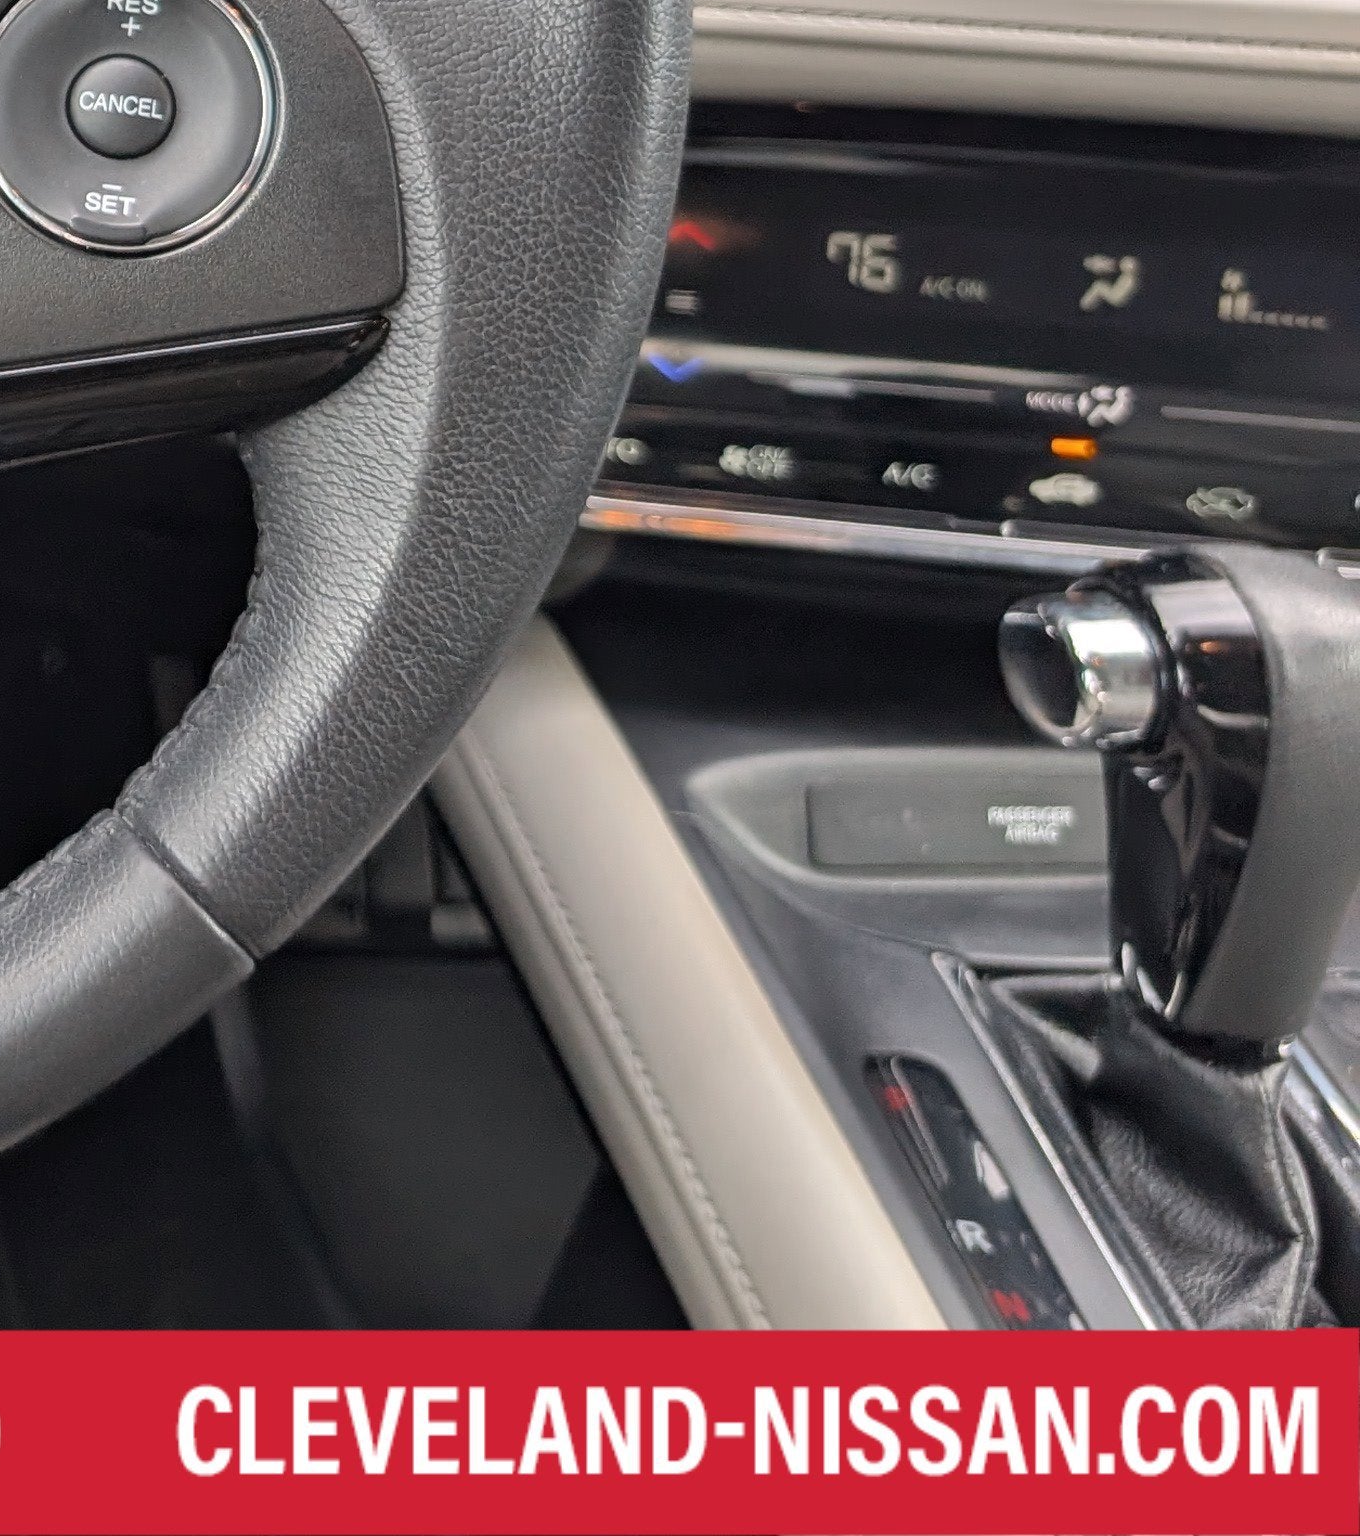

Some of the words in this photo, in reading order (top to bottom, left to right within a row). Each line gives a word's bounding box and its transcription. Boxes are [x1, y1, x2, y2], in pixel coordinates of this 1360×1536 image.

[79, 90, 163, 120] CANCEL
[84, 192, 136, 217] SET
[827, 231, 900, 294] 76
[955, 1218, 994, 1254] R
